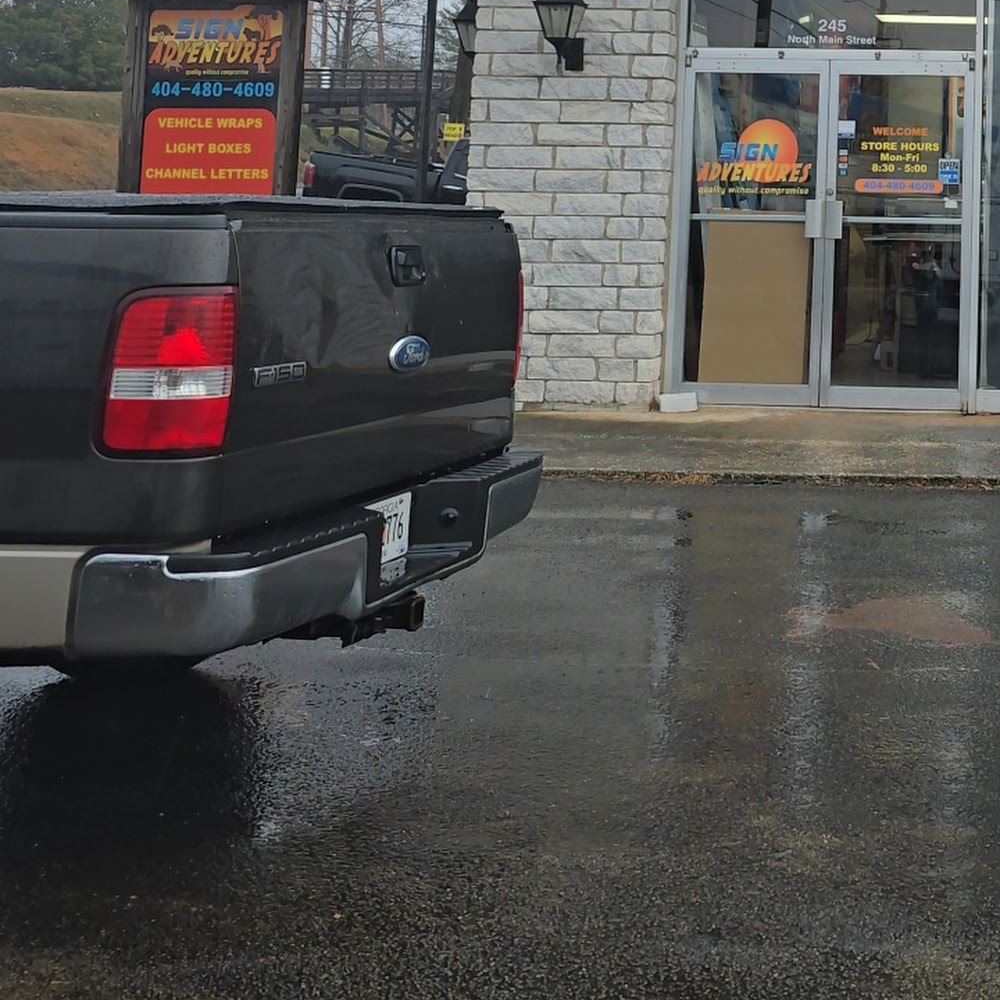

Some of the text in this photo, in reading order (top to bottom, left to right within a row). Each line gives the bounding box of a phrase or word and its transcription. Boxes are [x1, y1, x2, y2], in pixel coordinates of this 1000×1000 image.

[175, 17, 244, 40] SIGN
[818, 19, 847, 32] 245
[818, 34, 843, 44] Main
[846, 35, 877, 45] Street
[148, 40, 281, 65] ADVENTURES
[151, 81, 275, 98] 404-480-4609
[158, 117, 263, 129] VEHICLE WRAPS
[873, 126, 929, 136] WELCOME
[165, 143, 251, 155] LIGHT BOXES
[719, 142, 778, 162] SIGN
[861, 141, 940, 152] STORE HOURS
[880, 152, 920, 162] Mon-Fri
[146, 168, 268, 180] CHANNEL LETTERS
[697, 162, 812, 183] ADVENTURES
[871, 163, 895, 173] 8:30
[904, 164, 928, 173] 5:00
[698, 185, 810, 196] quality without compromise
[864, 181, 935, 190] 404-480-4609
[404, 343, 425, 364] Ford
